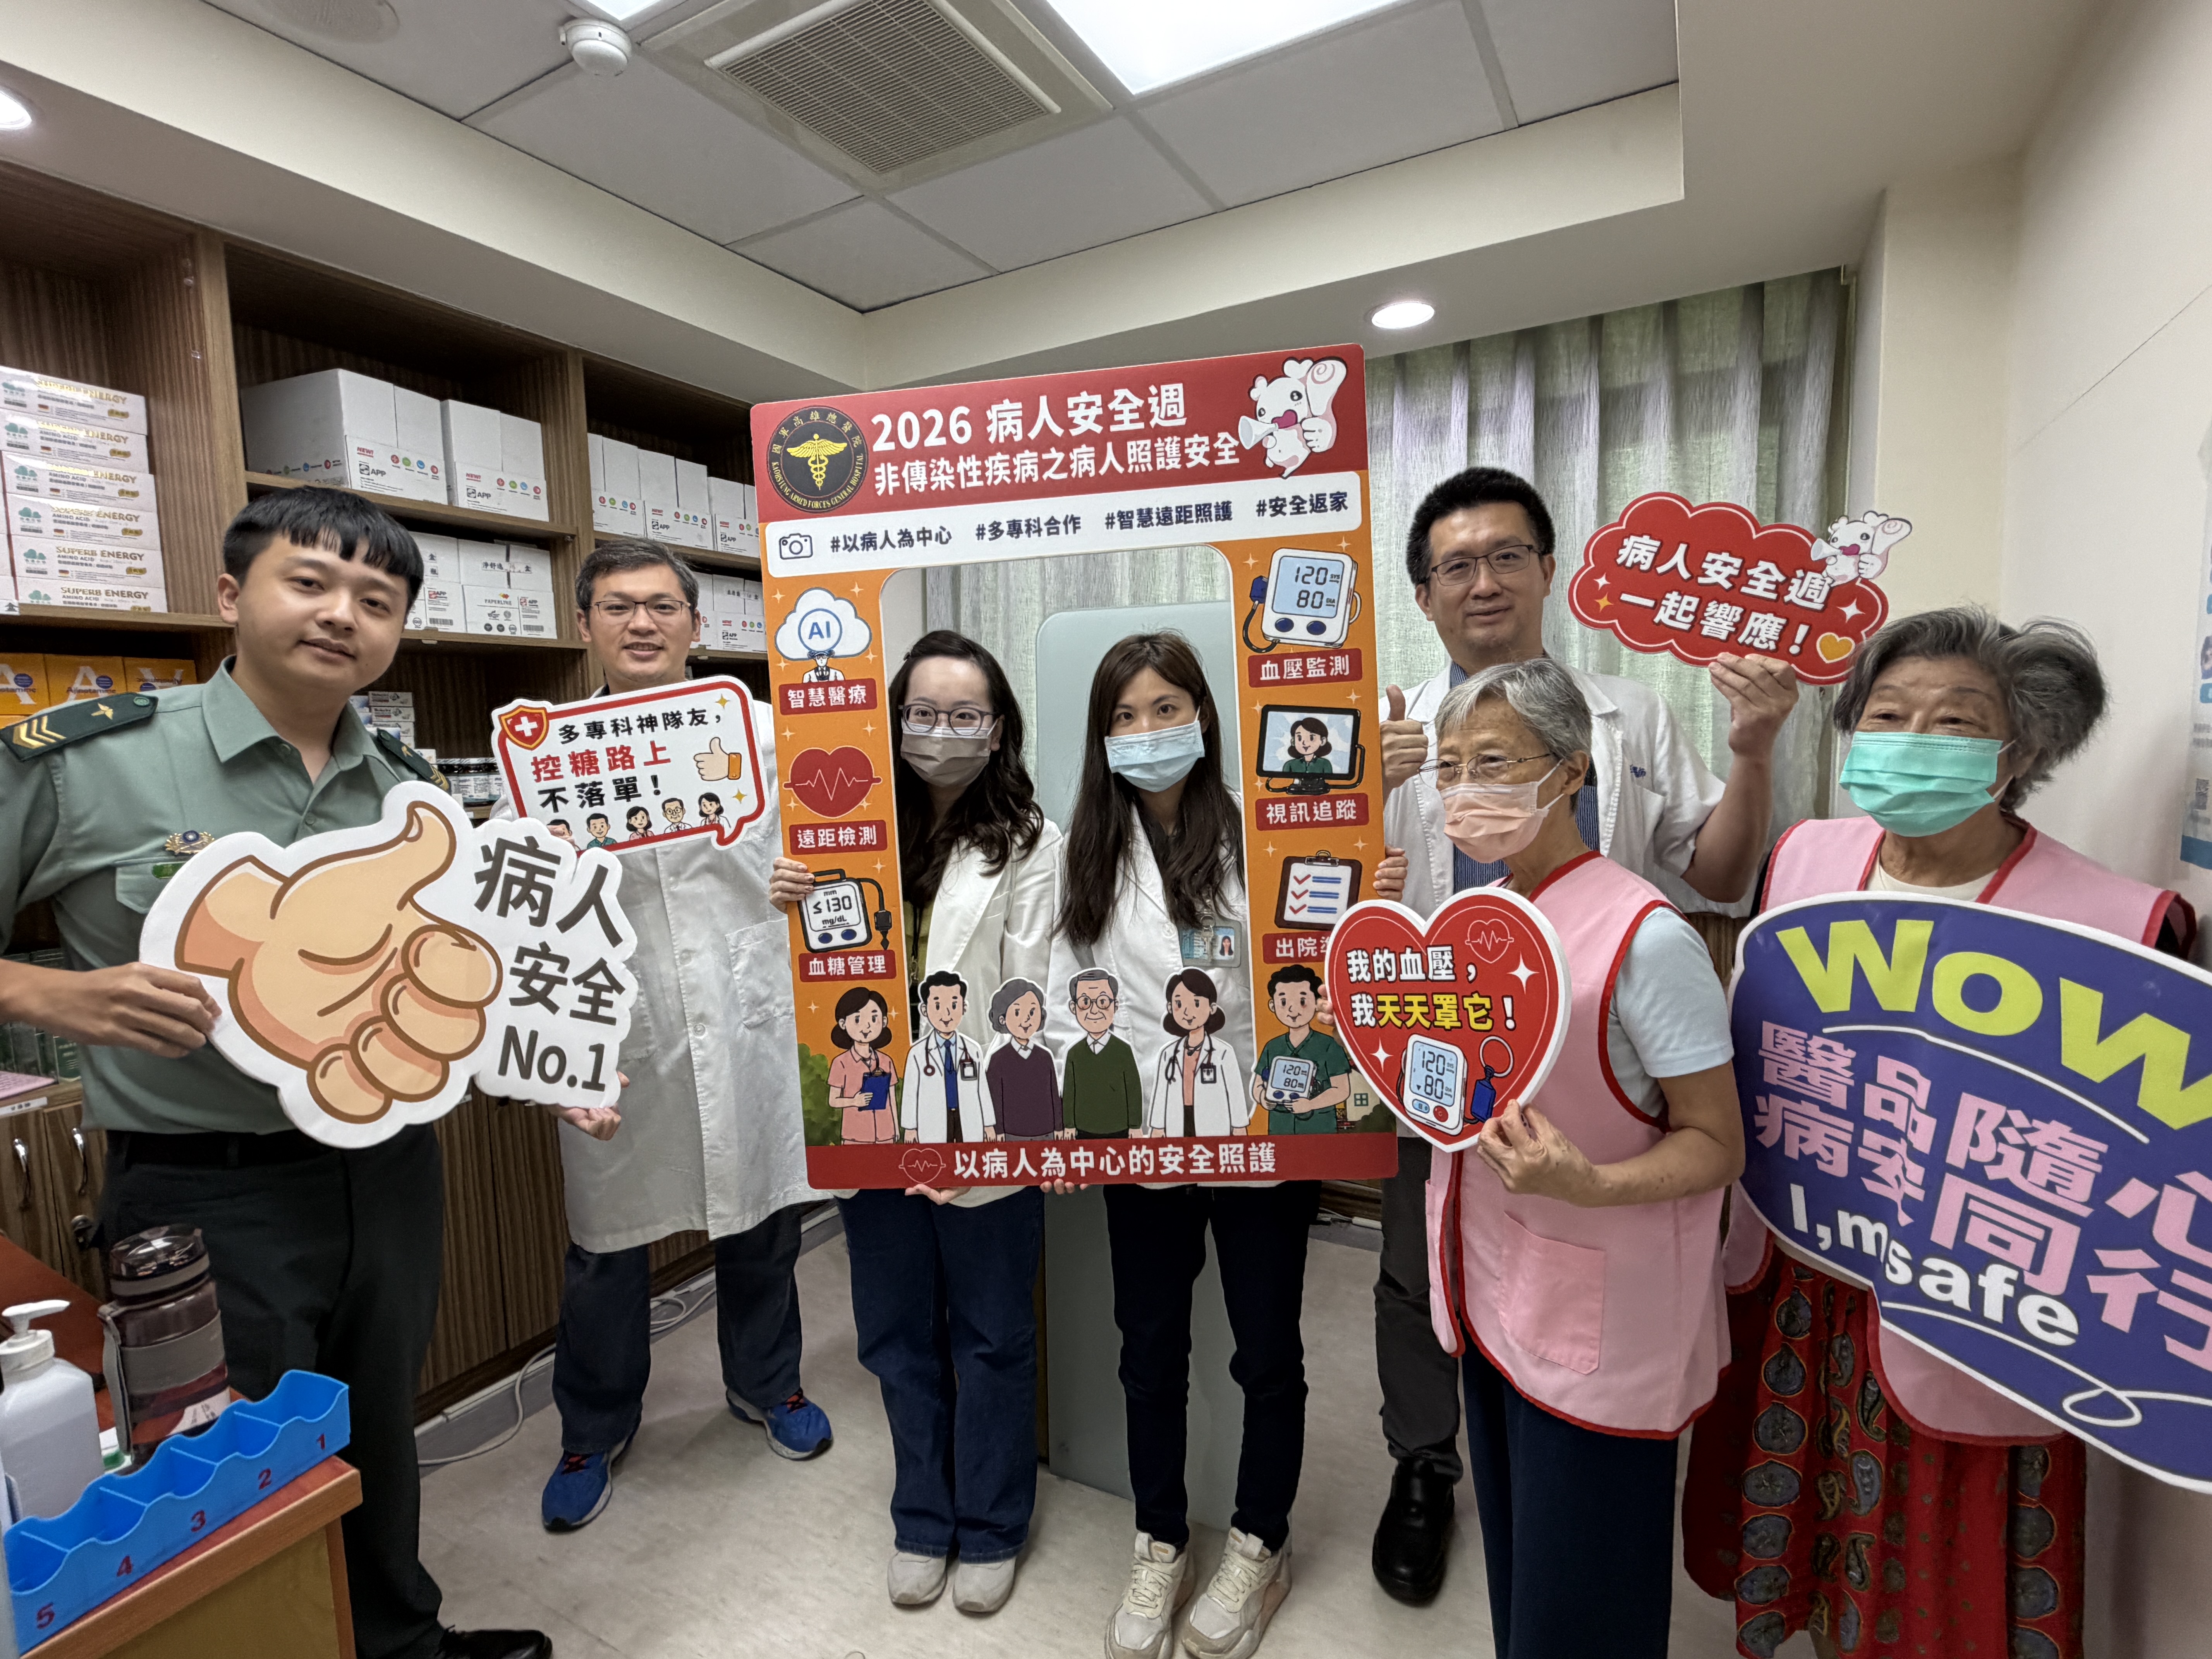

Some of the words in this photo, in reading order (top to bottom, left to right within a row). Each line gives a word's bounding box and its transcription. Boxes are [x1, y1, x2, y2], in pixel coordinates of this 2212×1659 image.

[871, 406, 972, 451] 2026
[986, 383, 1187, 443] 病人安全週
[371, 469, 386, 477] APP
[874, 432, 1239, 496] 非傳染性疾病之病人照護安全
[96, 510, 140, 522] ENERGY
[1105, 501, 1233, 530] #智慧遠距照護
[1256, 491, 1348, 517] #安全返家
[831, 525, 952, 552] #以病人為中心
[975, 514, 1081, 541] #多專科合作
[56, 546, 98, 556] SUPERB
[101, 550, 145, 561] ENERGY
[1295, 566, 1328, 585] 120
[1617, 535, 1833, 611] 病人安全週
[61, 587, 102, 596] SUPERB
[105, 589, 149, 599] ENERGY
[1297, 590, 1324, 609] 80
[808, 621, 831, 639] AI
[1620, 591, 1810, 654] 一起響應！
[1260, 655, 1350, 680] 血壓監測
[788, 685, 867, 709] 智慧醫療
[558, 708, 723, 744] 多專科神隊友，
[531, 740, 671, 783] 控糖路上
[537, 775, 661, 813] 不落單！
[1267, 799, 1357, 824] 視訊追蹤
[797, 825, 877, 848] 遠距檢測
[474, 836, 623, 948] 病人
[822, 915, 847, 925] mg/dL
[808, 955, 886, 976] 血糖管理
[1346, 946, 1477, 982] 我的血壓，
[509, 941, 625, 1025] 安全
[1351, 993, 1516, 1030] 我天天罩它！
[1776, 919, 2212, 1130] WOW
[498, 1025, 606, 1092] No.1
[1283, 1065, 1301, 1076] 120
[1422, 1051, 1446, 1076] 120
[1284, 1078, 1298, 1088] 80
[1424, 1075, 1444, 1100] 80
[953, 1142, 1276, 1178] 以病人為中心的安全照護
[1885, 1240, 2079, 1346] safe
[316, 1434, 326, 1451] 1
[258, 1469, 272, 1489] 2
[191, 1510, 206, 1532] 3
[117, 1556, 133, 1577] 4
[36, 1602, 55, 1629] 5
